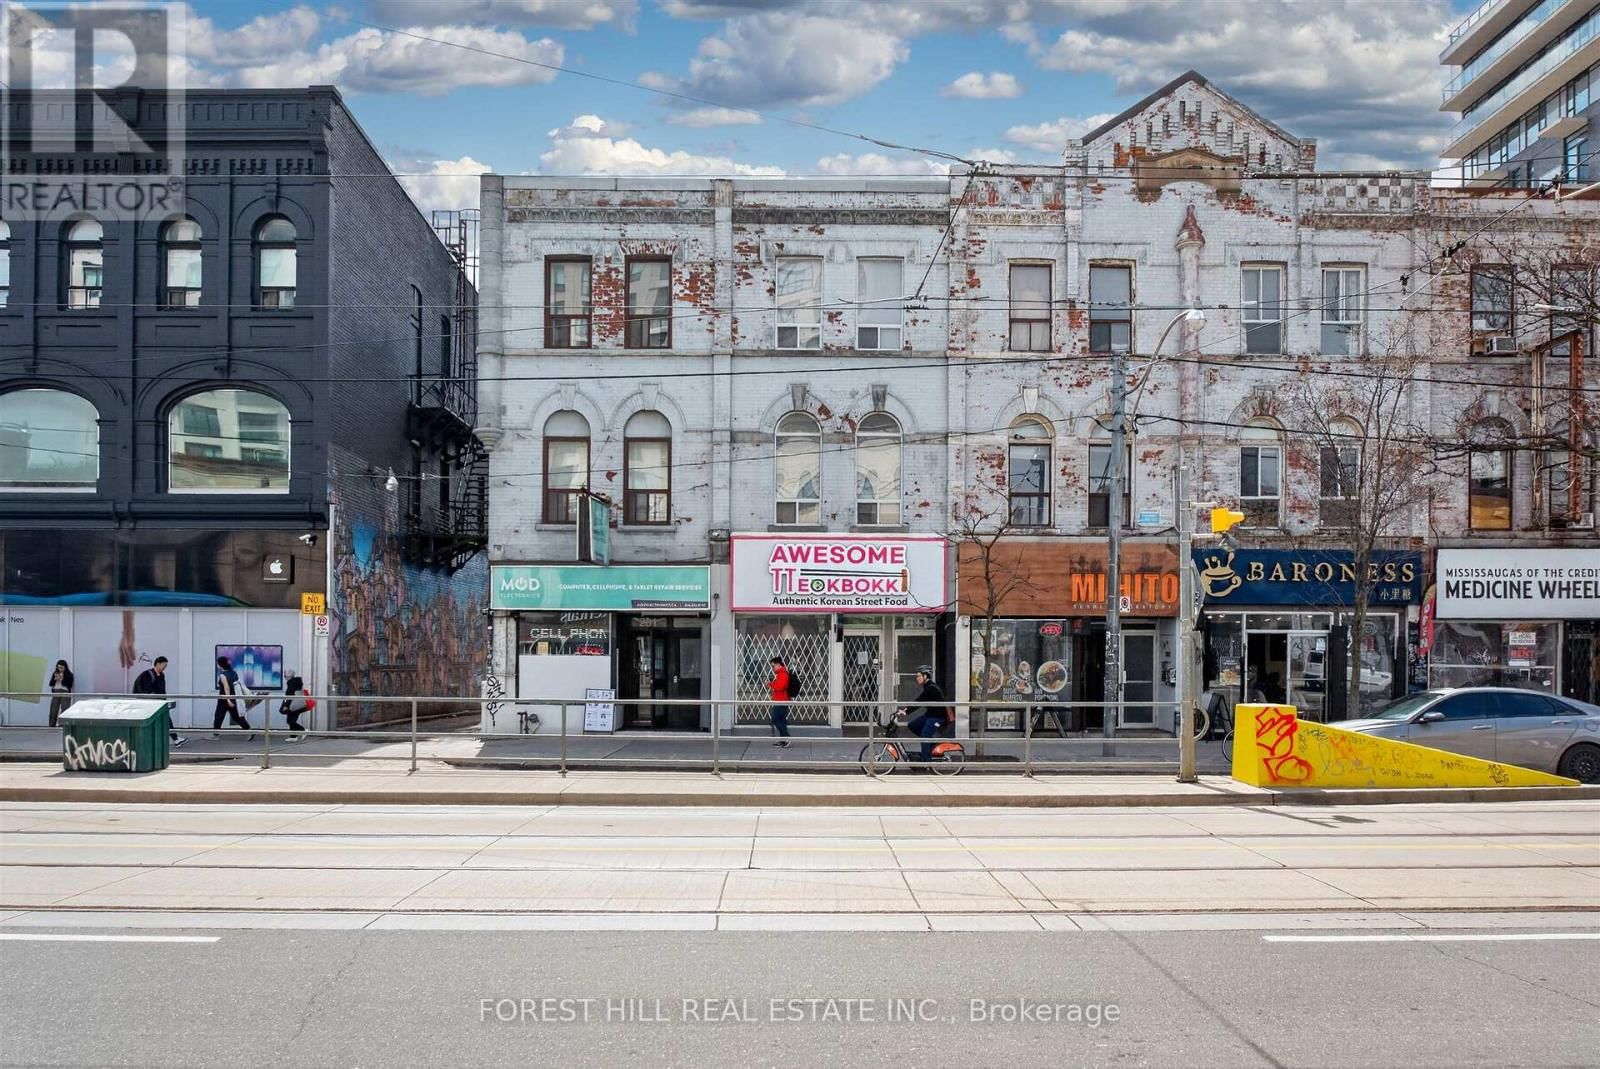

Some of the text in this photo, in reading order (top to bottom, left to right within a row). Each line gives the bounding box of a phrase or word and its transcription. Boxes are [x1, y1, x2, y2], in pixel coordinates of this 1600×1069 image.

[771, 546, 904, 563] AWESOME
[1247, 562, 1414, 582] BARONESS
[1446, 568, 1522, 578] MISSISSAUGAS
[1527, 568, 1539, 578] OF
[1544, 568, 1563, 578] THE
[501, 576, 540, 591] MOD
[1446, 580, 1533, 599] MEDICINE
[307, 596, 319, 604] NO
[773, 597, 908, 605] Authentic Korean Street Food
[305, 604, 321, 612] EXIT
[530, 628, 562, 639] CELL
